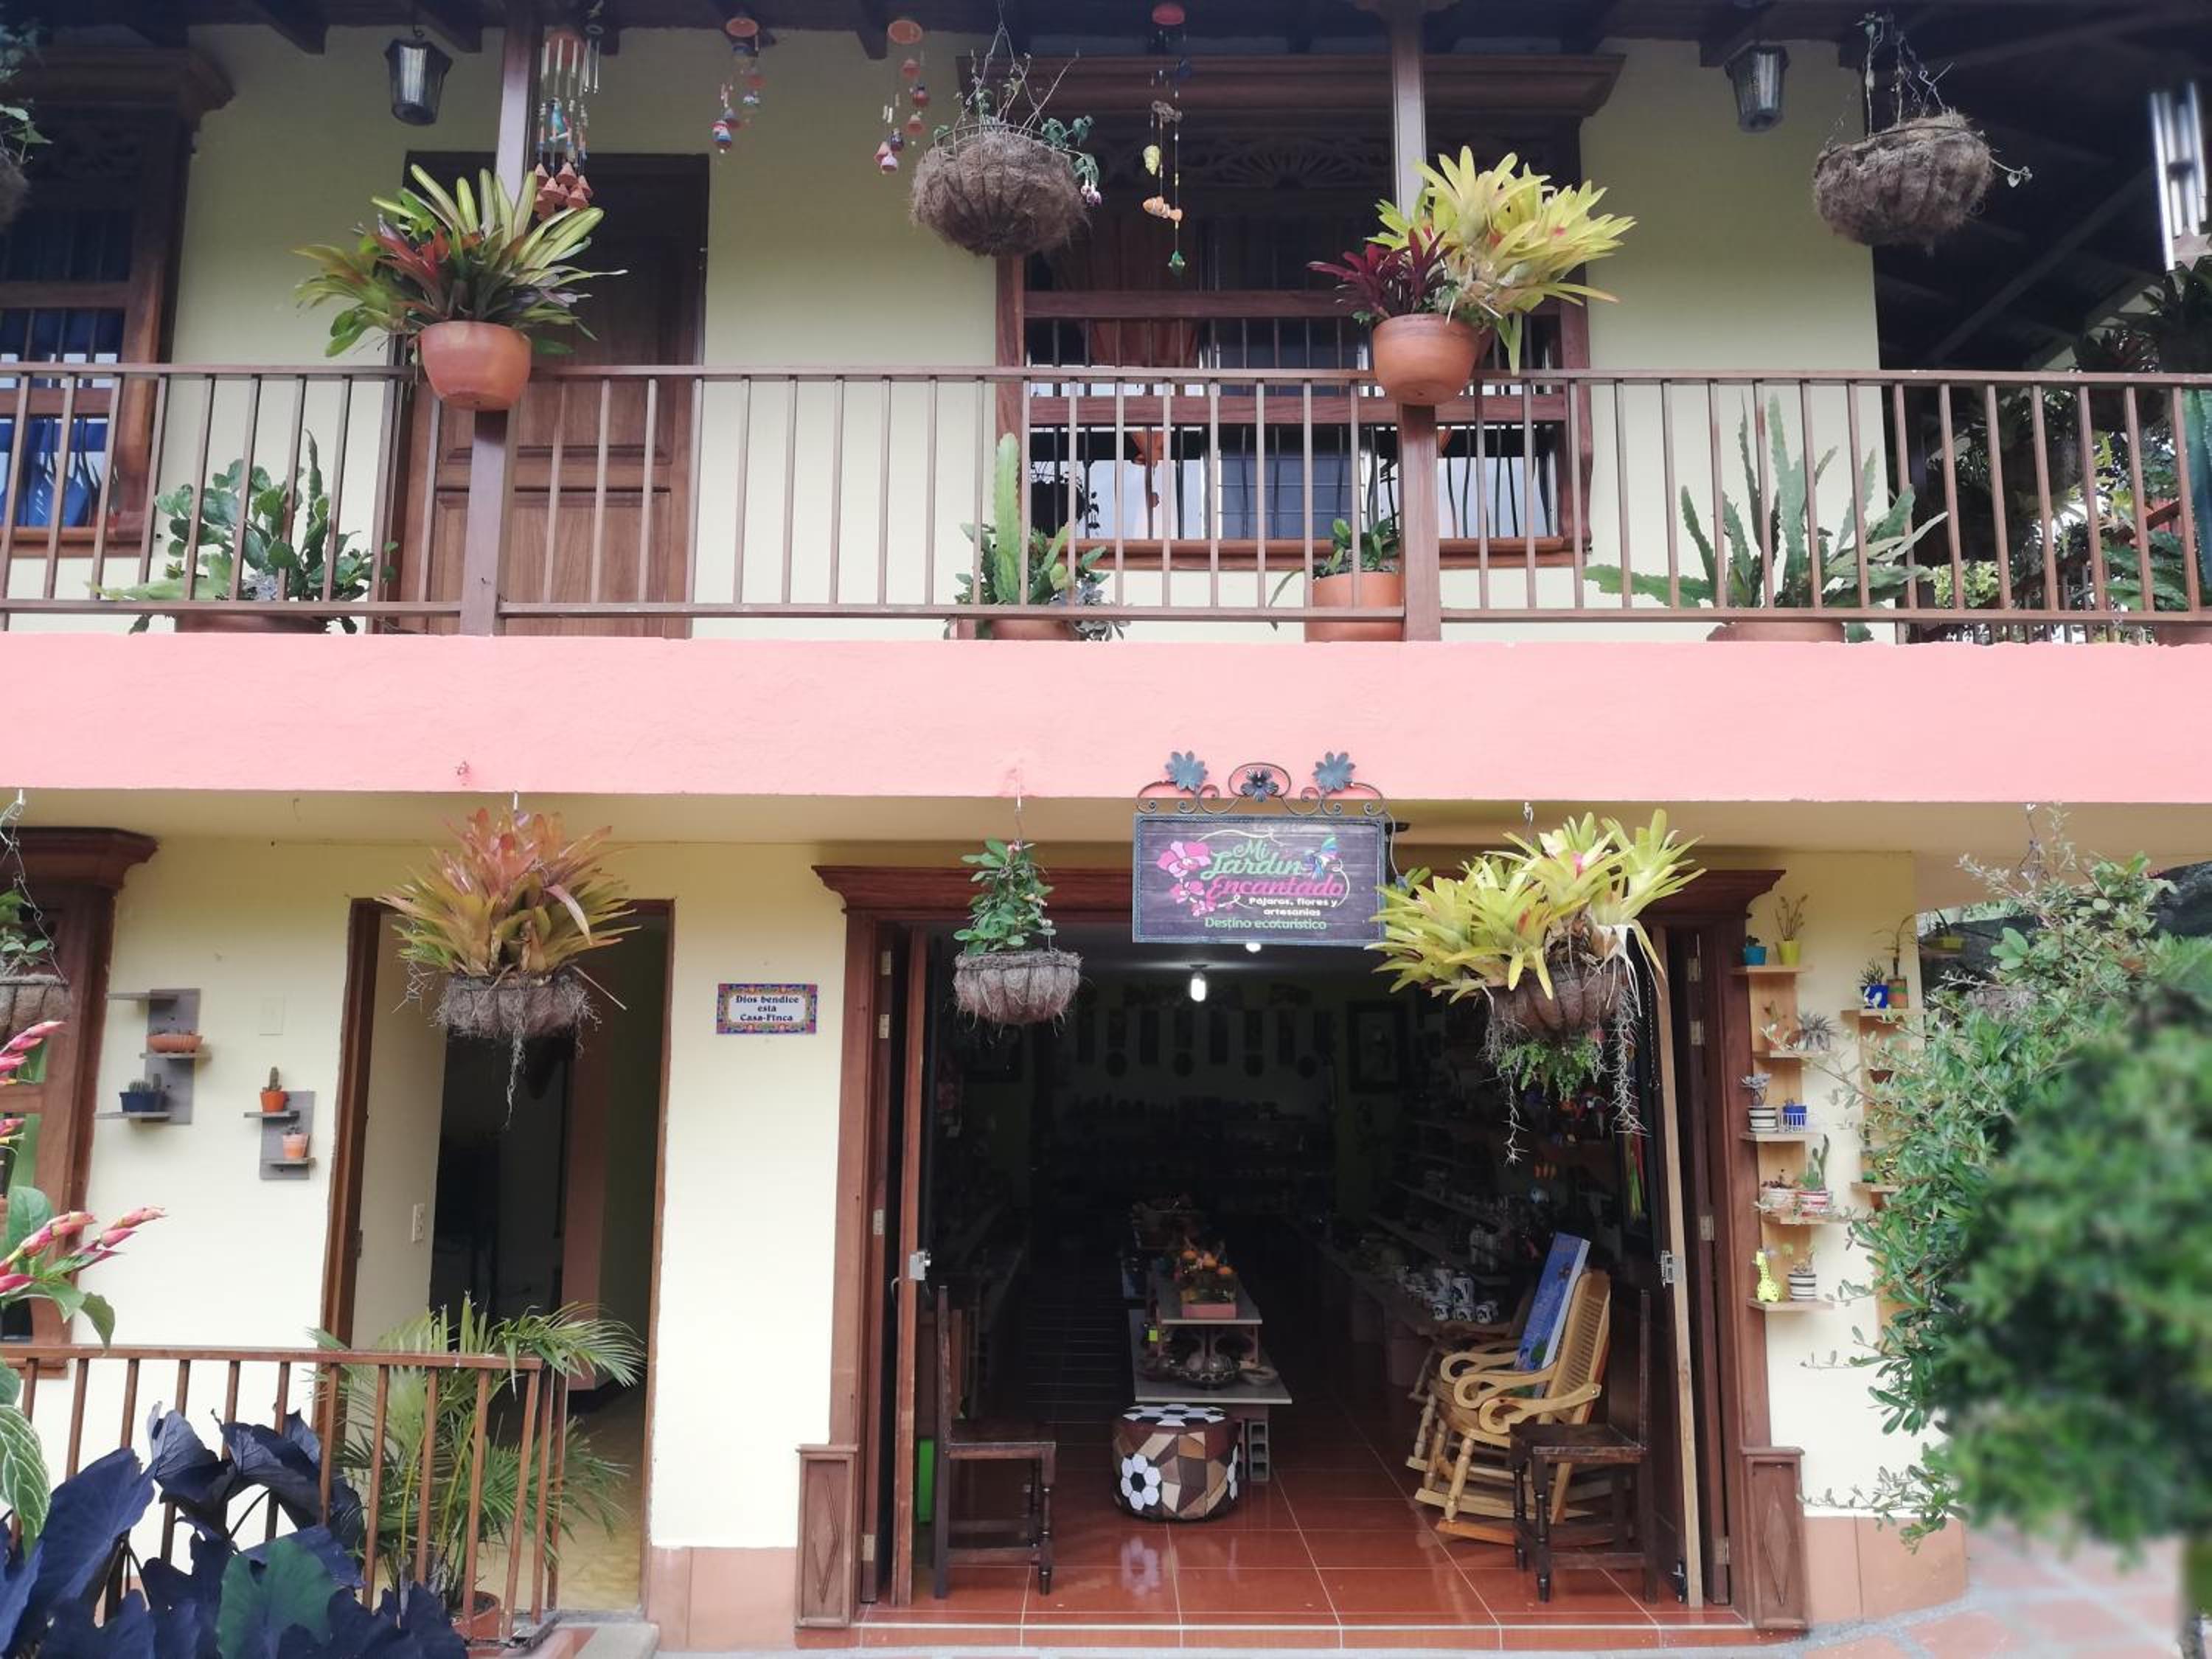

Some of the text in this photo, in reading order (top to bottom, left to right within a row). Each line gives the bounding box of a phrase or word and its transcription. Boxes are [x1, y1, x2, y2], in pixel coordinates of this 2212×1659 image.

[1233, 838, 1268, 861] Mi
[1208, 874, 1344, 896] Encantado
[1297, 897, 1329, 906] flores
[1330, 899, 1338, 908] y
[1204, 917, 1252, 931] Destino
[735, 995, 800, 1004] Dios bendice
[740, 1014, 793, 1022] Casa-Finca
